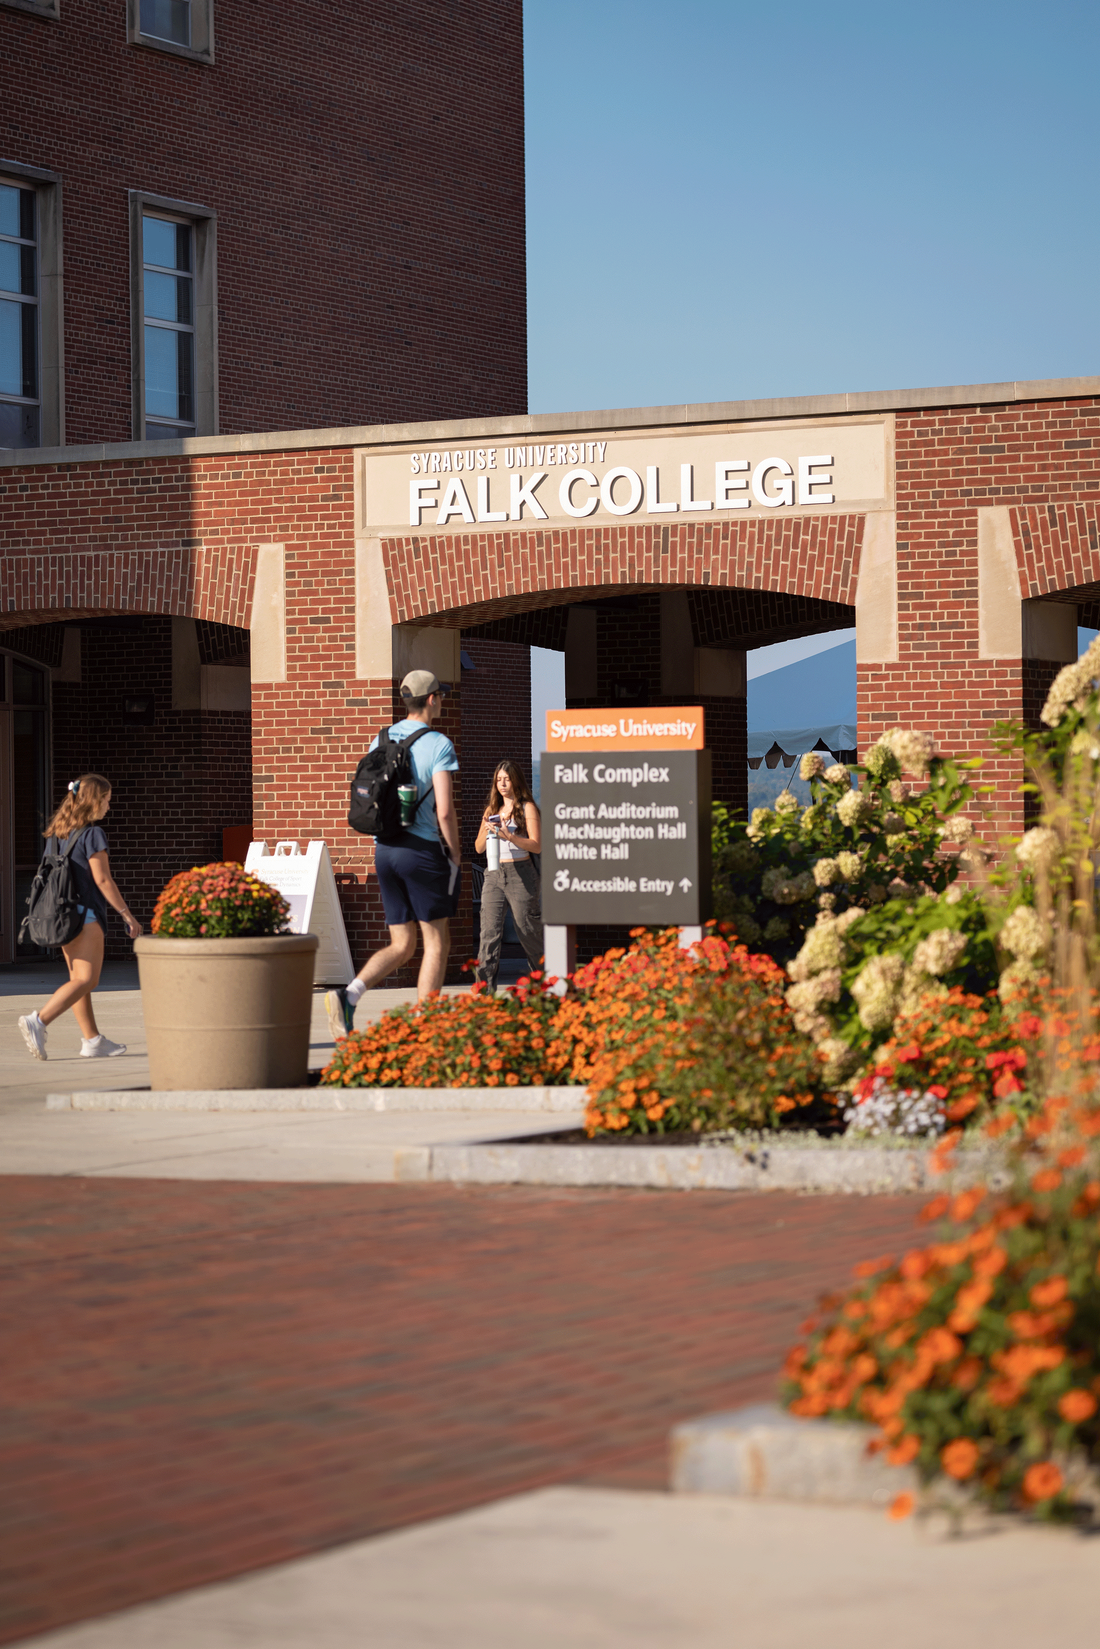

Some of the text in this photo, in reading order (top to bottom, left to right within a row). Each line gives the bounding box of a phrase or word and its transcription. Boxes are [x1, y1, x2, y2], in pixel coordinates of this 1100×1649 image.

[410, 441, 608, 474] SYRACUSE UNIVERSITY
[409, 454, 835, 527] FALK COLLEGE
[550, 718, 697, 742] Syracuse University
[554, 762, 670, 788] Falk Complex
[554, 802, 679, 820] Grant Auditorium
[554, 822, 687, 843] MacNaughton Hall
[555, 842, 629, 860] White Hall
[261, 868, 310, 876] Syracuse University
[570, 876, 675, 896] Accessible Entry
